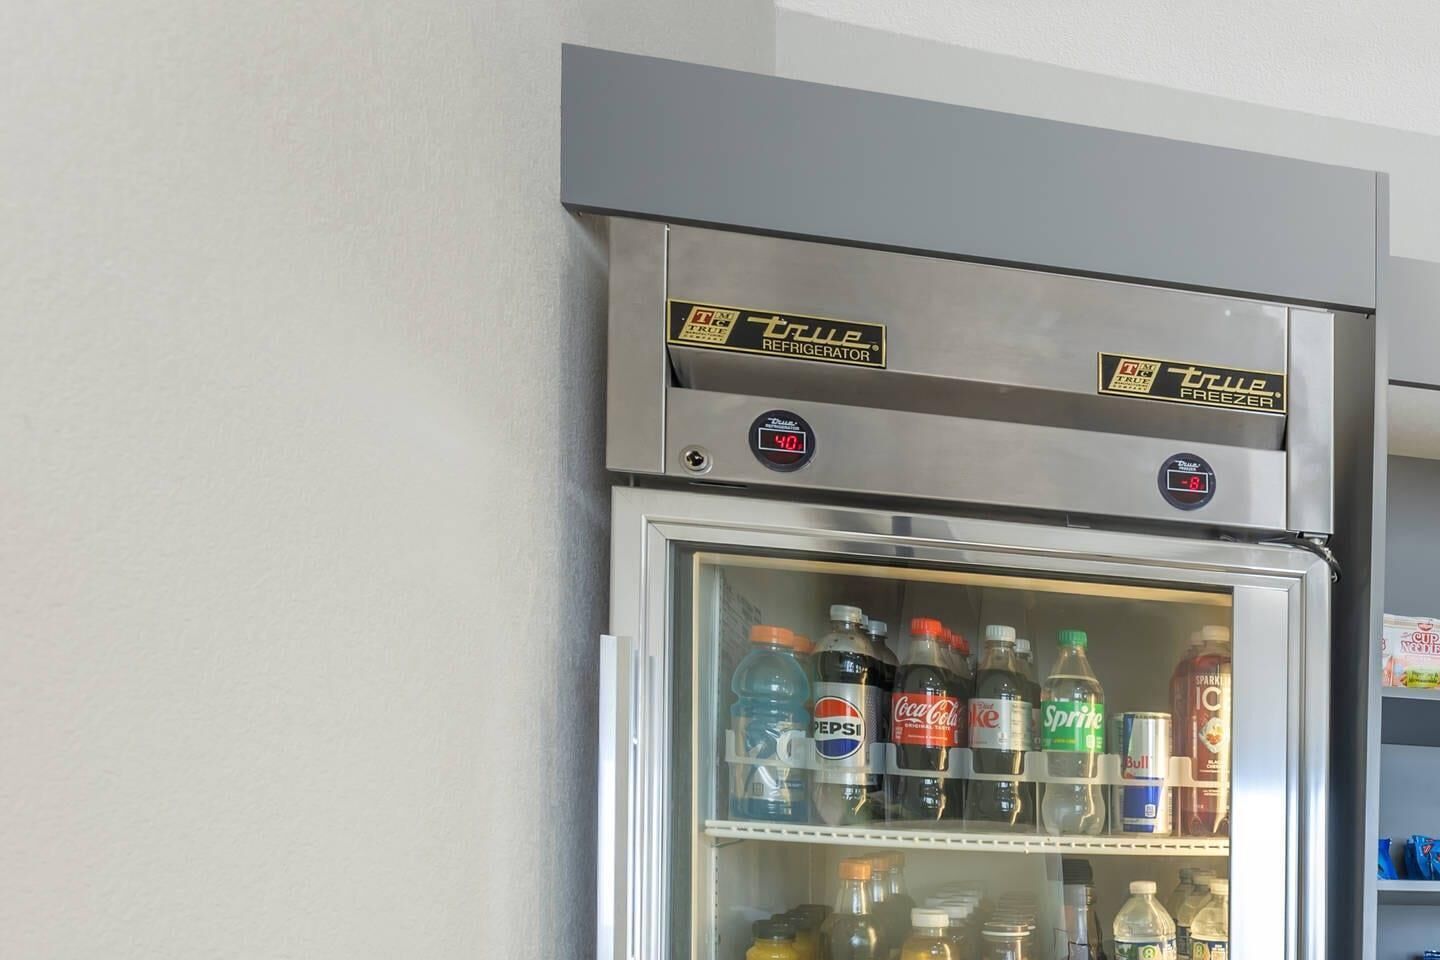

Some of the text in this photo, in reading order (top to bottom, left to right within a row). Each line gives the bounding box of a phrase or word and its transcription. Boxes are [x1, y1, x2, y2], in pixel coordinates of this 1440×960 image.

[688, 325, 727, 335] TRUE
[748, 316, 871, 348] true
[763, 339, 870, 361] REFRIGERATOR
[1168, 367, 1274, 397] true
[1181, 388, 1273, 408] FREEZER
[775, 435, 798, 450] 40
[1412, 632, 1440, 644] CUP
[1044, 704, 1103, 732] Sprite
[814, 721, 862, 736] PEPSI
